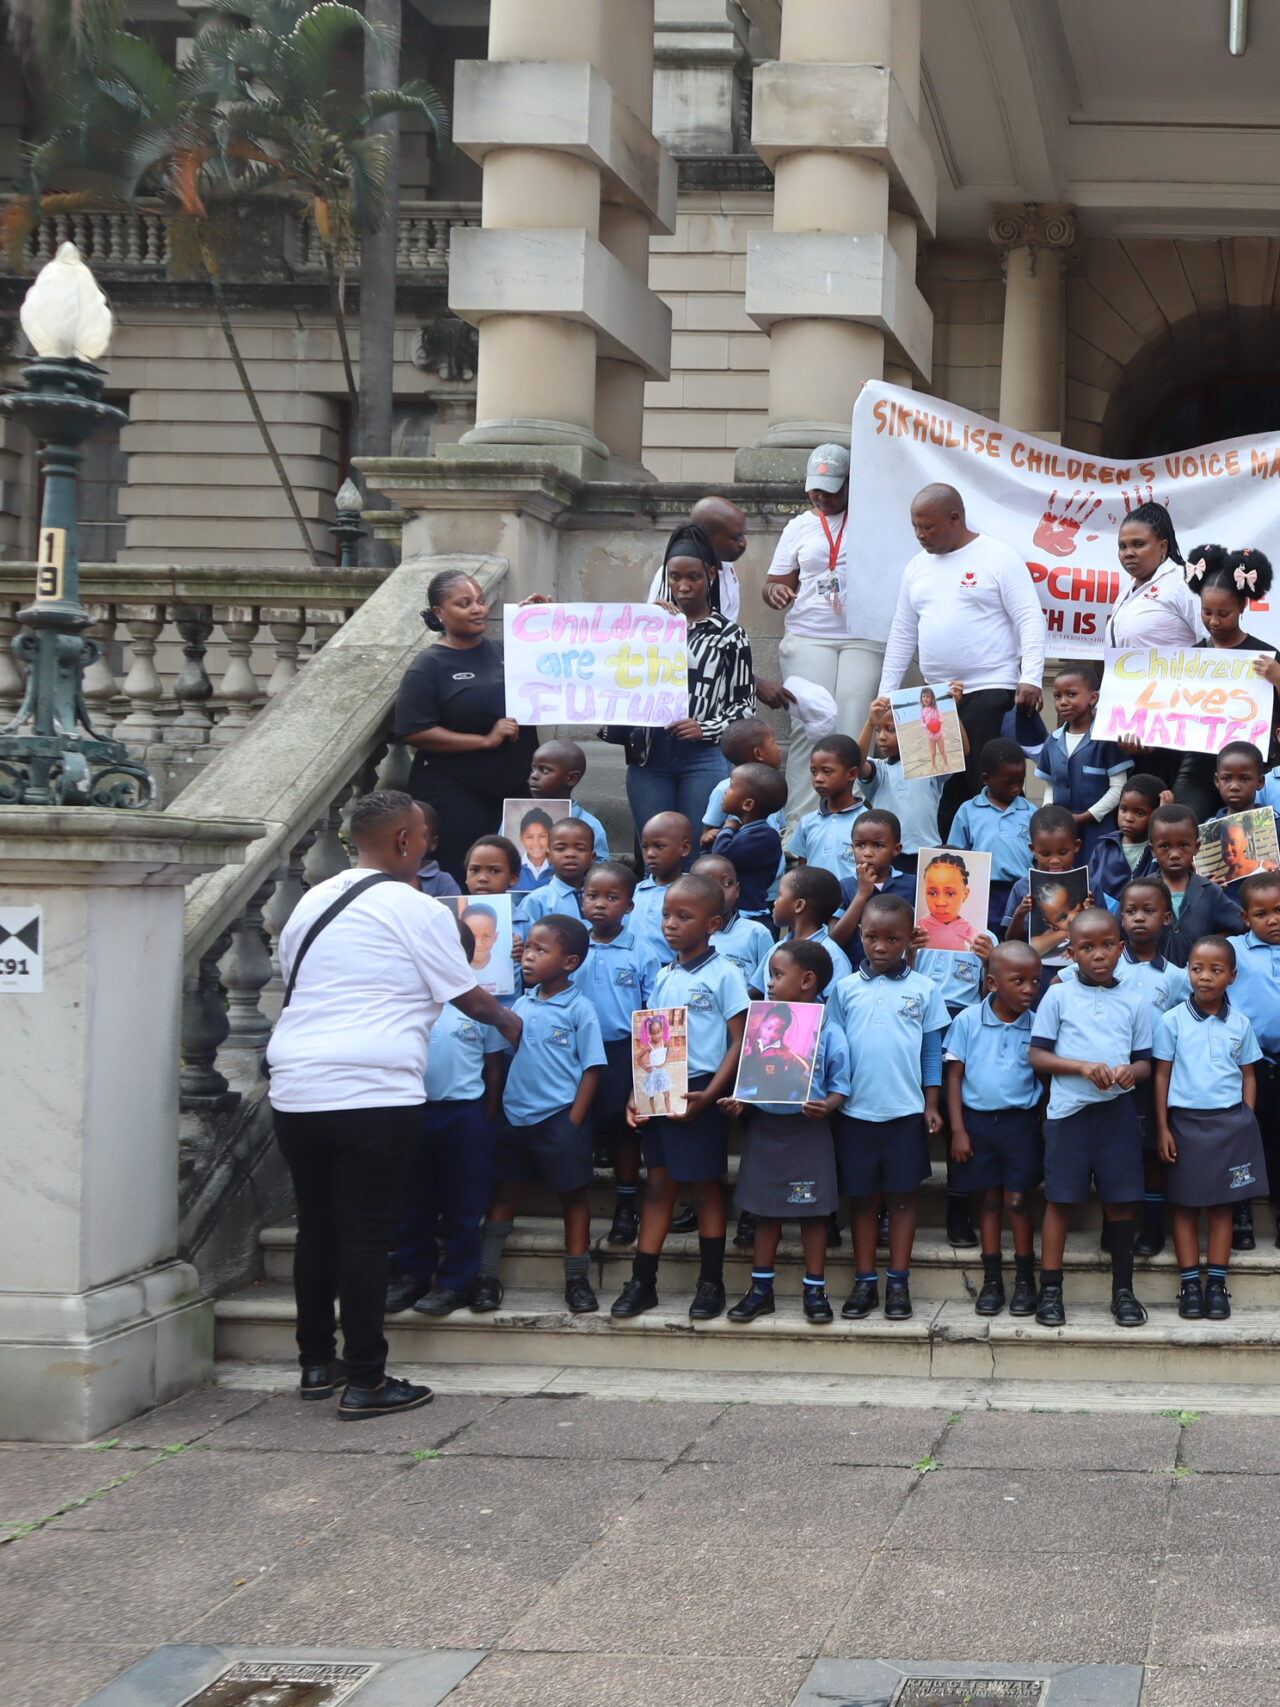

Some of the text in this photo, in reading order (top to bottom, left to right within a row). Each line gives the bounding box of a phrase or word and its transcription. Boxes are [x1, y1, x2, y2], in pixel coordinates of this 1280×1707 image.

[873, 399, 1003, 457] SIKHULISE
[1165, 449, 1241, 479] VOICE
[536, 643, 687, 689] are the
[1134, 681, 1259, 722] Lives
